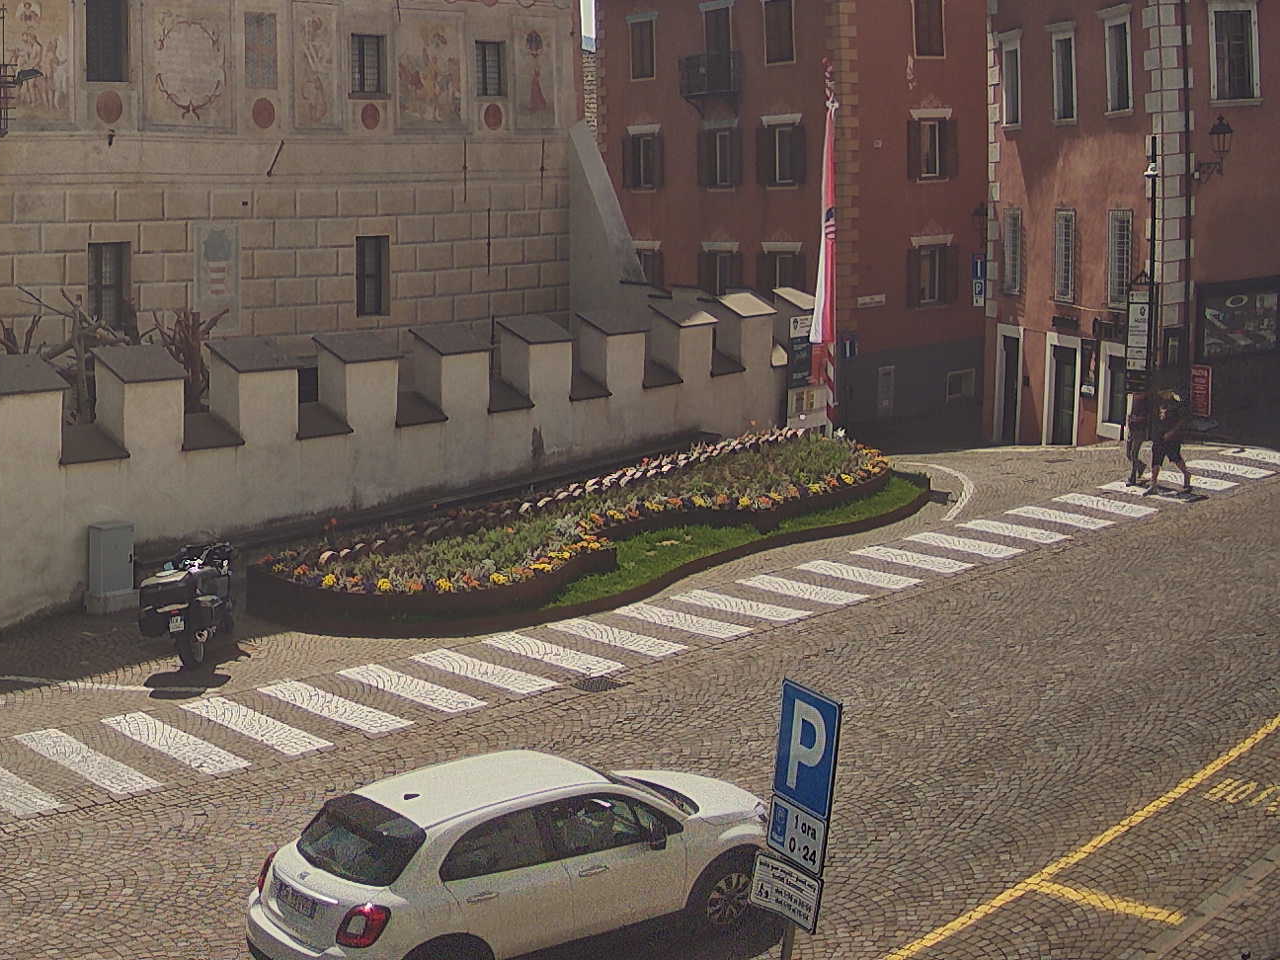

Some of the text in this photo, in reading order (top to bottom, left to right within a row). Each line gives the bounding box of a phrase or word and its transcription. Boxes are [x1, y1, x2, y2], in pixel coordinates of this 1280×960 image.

[786, 698, 827, 792] P
[794, 814, 817, 840] 1 ora
